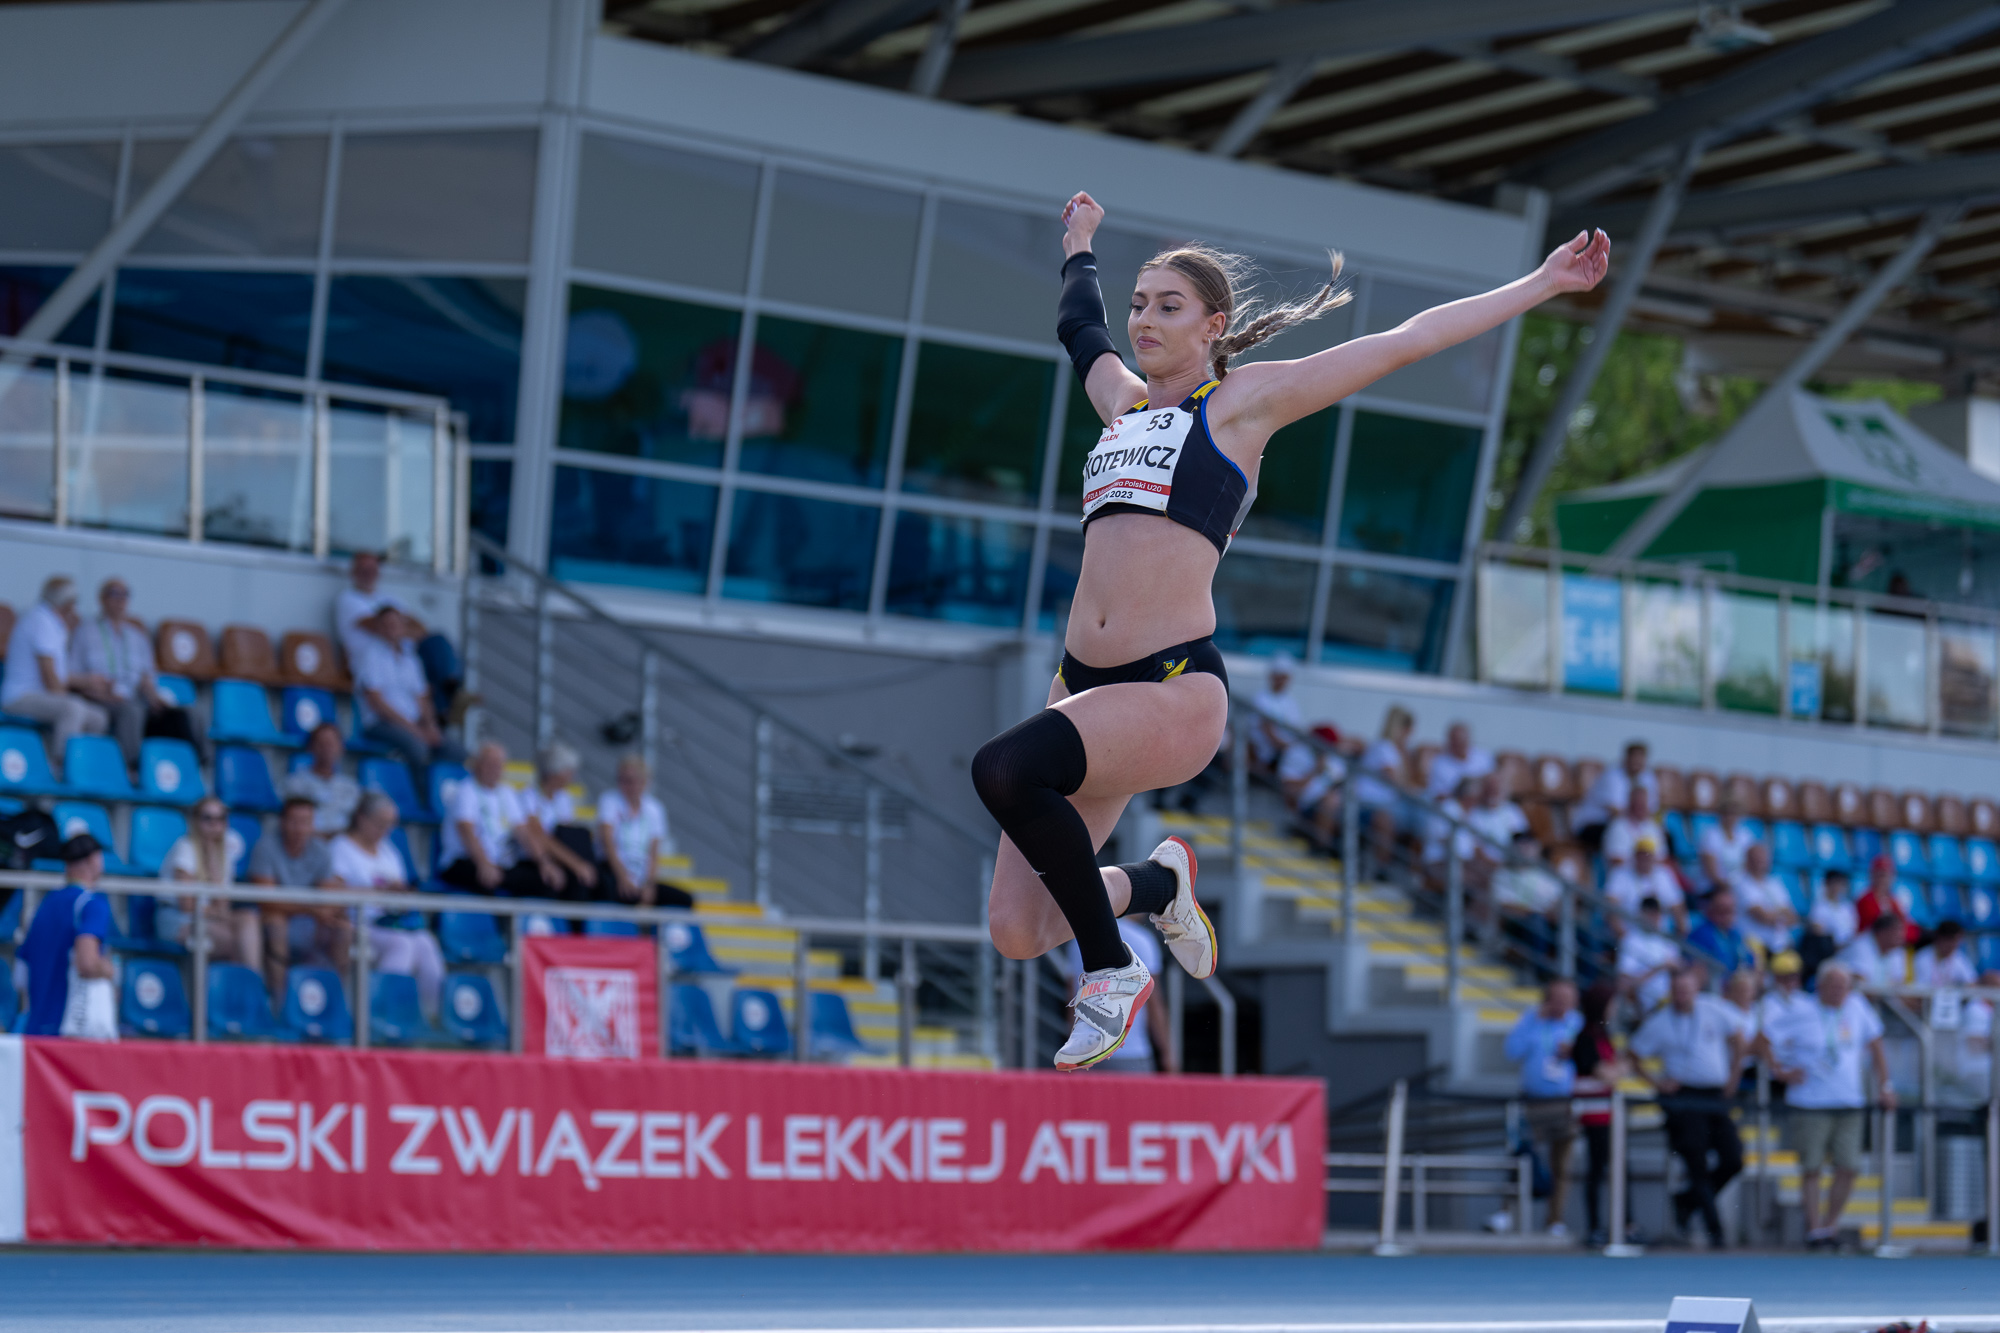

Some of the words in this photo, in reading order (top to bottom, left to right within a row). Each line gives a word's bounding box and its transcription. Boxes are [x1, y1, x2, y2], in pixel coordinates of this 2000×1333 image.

[1146, 413, 1174, 431] 53
[1110, 490, 1133, 499] 2023
[1124, 480, 1146, 489] Polski
[1147, 484, 1162, 492] U20
[1080, 980, 1111, 1000] NIKE
[71, 1090, 367, 1173] POLSKI
[389, 1105, 731, 1190] ZWIĄZEK
[746, 1113, 1006, 1183] LEKKIEJ
[1020, 1120, 1297, 1184] ATLETYKI
